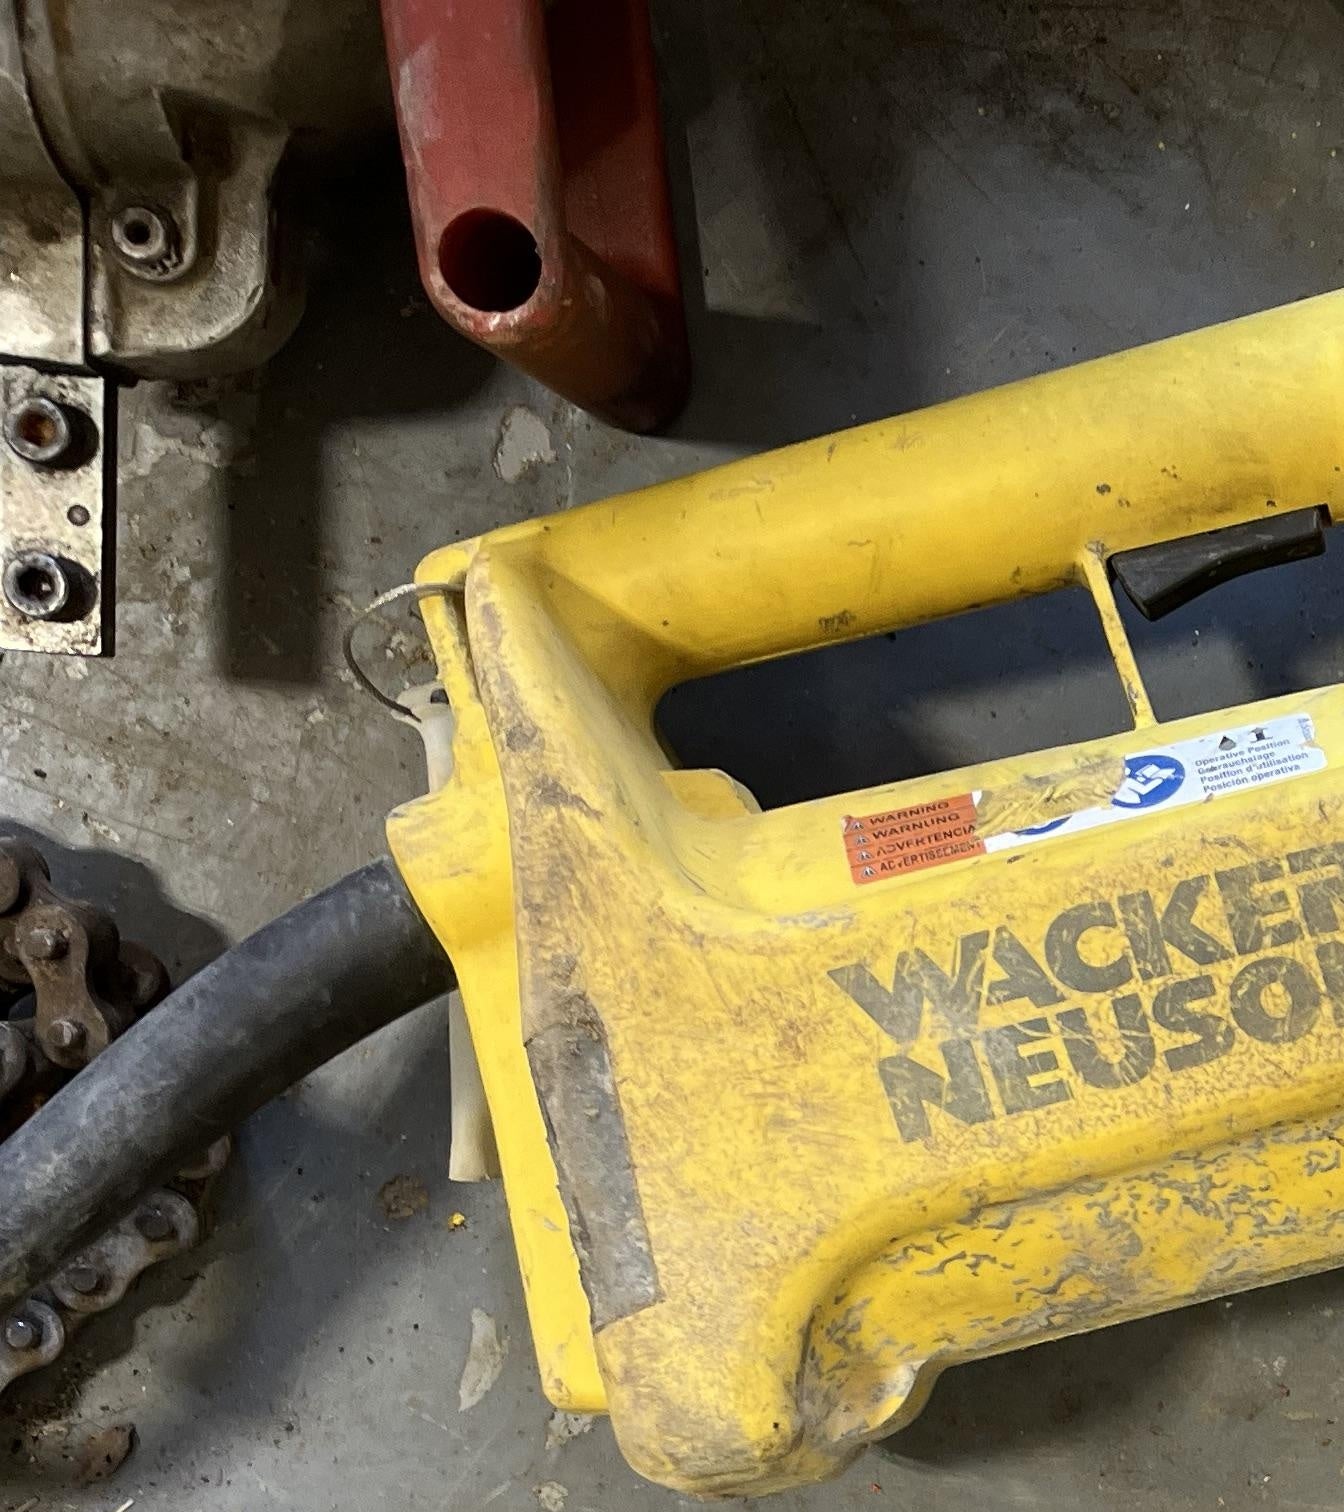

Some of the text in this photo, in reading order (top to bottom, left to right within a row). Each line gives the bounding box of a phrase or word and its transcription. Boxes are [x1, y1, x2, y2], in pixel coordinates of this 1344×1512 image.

[1195, 738, 1291, 767] Operative Position
[1200, 769, 1244, 785] Position
[1250, 763, 1301, 783] operativa
[869, 801, 950, 825] WARNING
